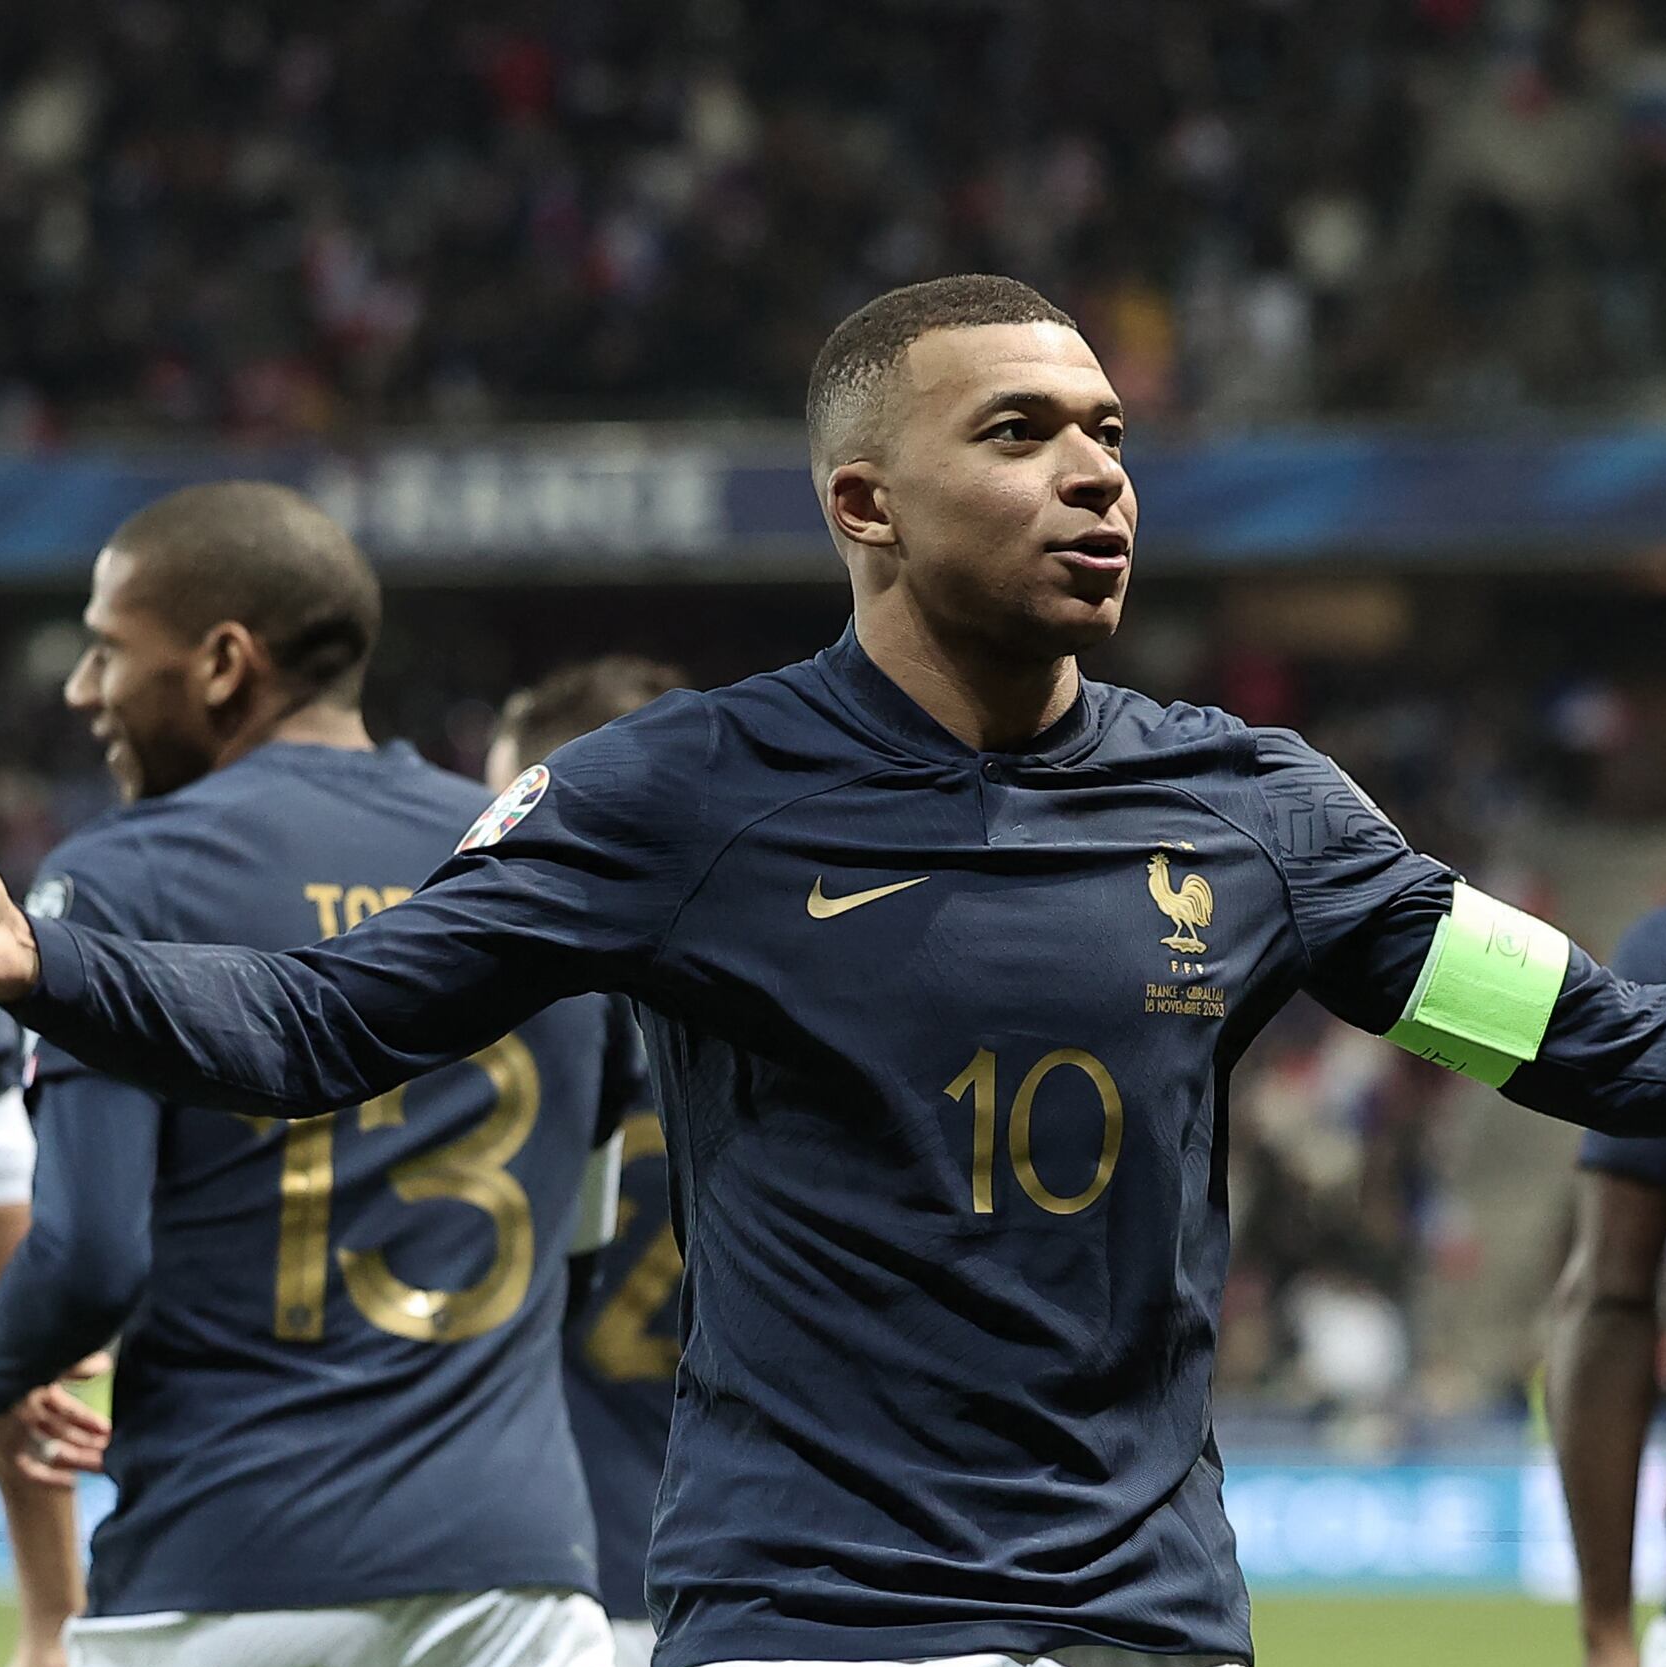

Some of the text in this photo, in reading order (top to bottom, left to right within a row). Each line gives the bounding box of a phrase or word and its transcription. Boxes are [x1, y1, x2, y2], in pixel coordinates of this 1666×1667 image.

[304, 882, 415, 940] TO
[1144, 999, 1225, 1018] 18 NOVEMBRE 2023
[1146, 983, 1179, 999] FRANCE
[944, 1046, 1125, 1215] 10
[233, 1032, 541, 1345] 13
